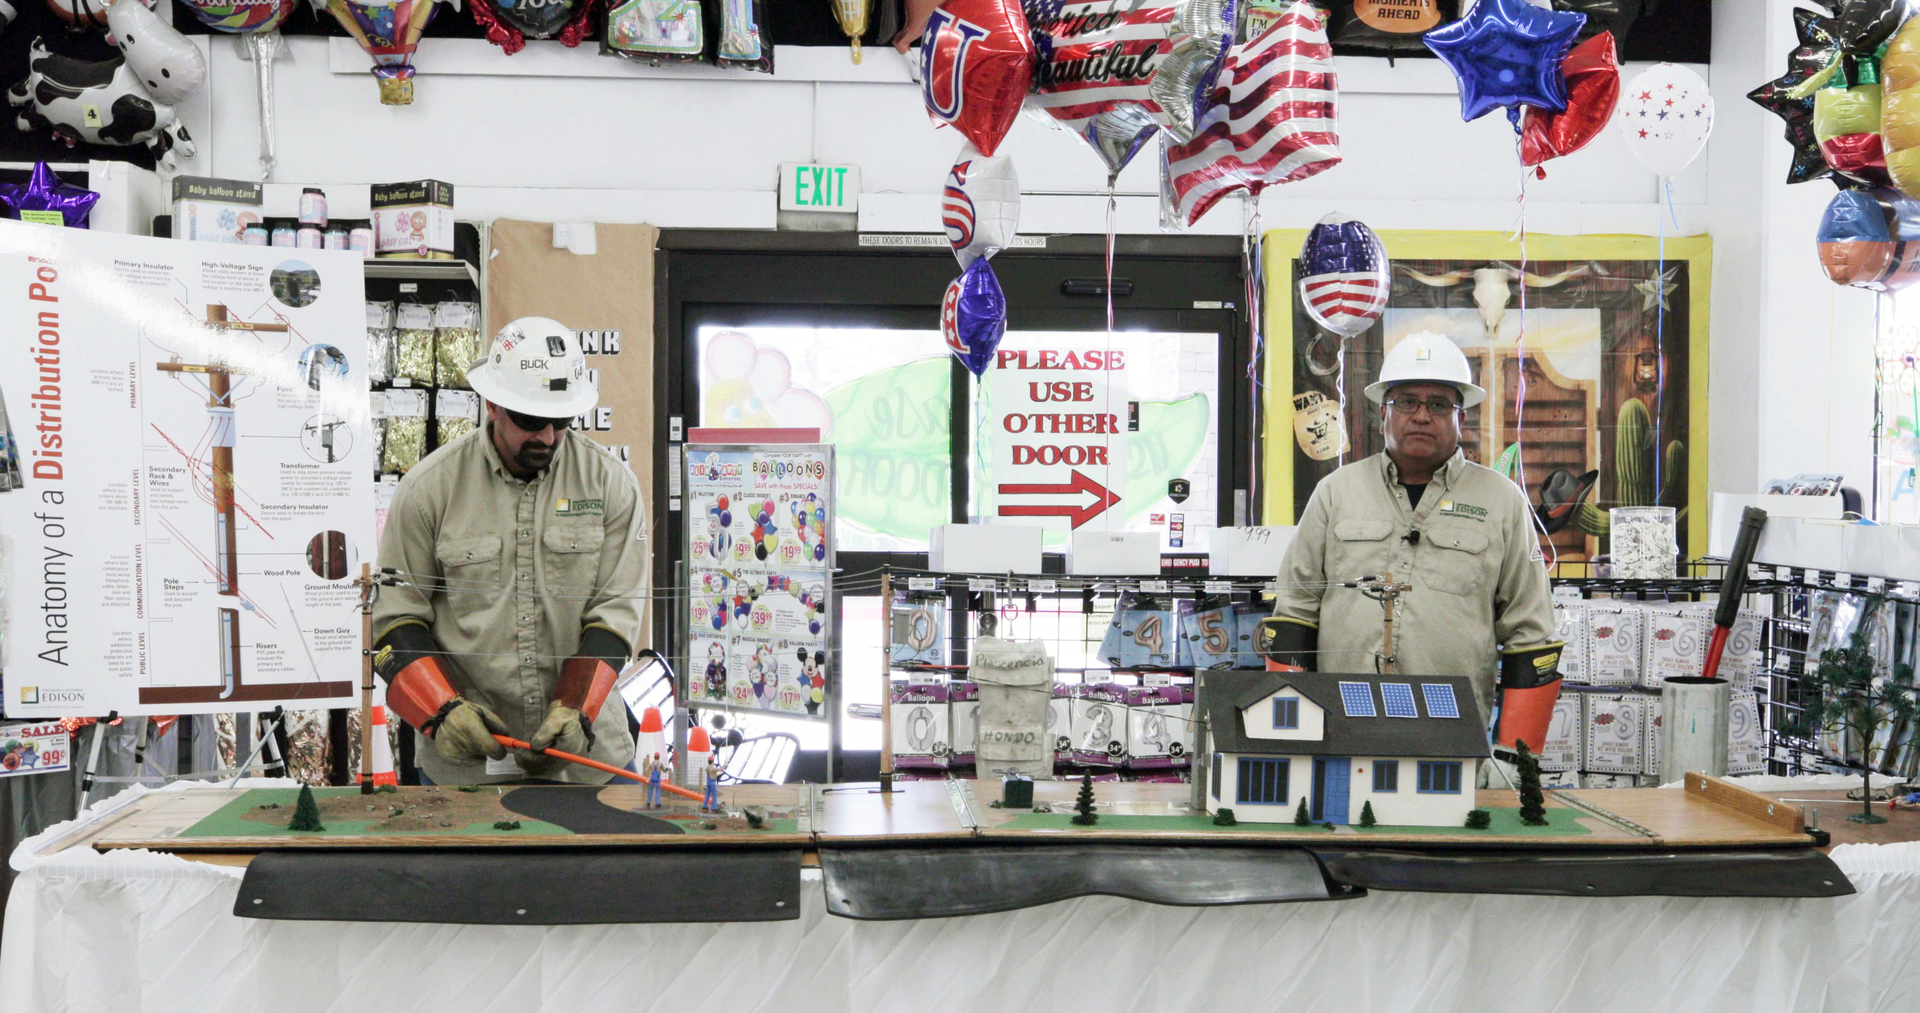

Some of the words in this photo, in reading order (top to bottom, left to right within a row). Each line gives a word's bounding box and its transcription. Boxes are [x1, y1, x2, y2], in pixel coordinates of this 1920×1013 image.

[1377, 8, 1420, 20] AHEAD
[1252, 18, 1268, 29] I'M
[921, 7, 990, 122] U
[87, 108, 97, 120] 4
[189, 185, 207, 195] Baby
[209, 186, 234, 196] balloon
[236, 189, 256, 199] stand
[795, 166, 847, 207] EXIT
[1024, 238, 1044, 246] HOURS
[114, 260, 141, 268] Primary
[202, 261, 246, 270] High-Voltage
[247, 264, 263, 272] Sign
[520, 359, 549, 370] BUCK
[996, 350, 1125, 371] PLEASE
[30, 312, 63, 480] Distribution
[1029, 381, 1093, 403] USE
[1003, 413, 1120, 434] OTHER
[1012, 445, 1109, 467] DOOR
[149, 465, 186, 474] Secondary
[752, 460, 824, 478] BALLOONS
[42, 490, 64, 504] a
[733, 491, 743, 501] #2
[779, 492, 790, 502] #3
[573, 502, 603, 511] EDISON
[1456, 506, 1486, 518] EDISON
[34, 512, 65, 538] of
[733, 567, 742, 578] #5
[38, 546, 73, 666] Anatomy
[732, 635, 741, 645] #7
[778, 639, 788, 649] #8
[42, 692, 85, 702] EDISON
[1088, 691, 1115, 700] Balloon
[1142, 696, 1169, 704] Balloon
[21, 724, 64, 738] SALE
[984, 731, 1035, 744] HONDO
